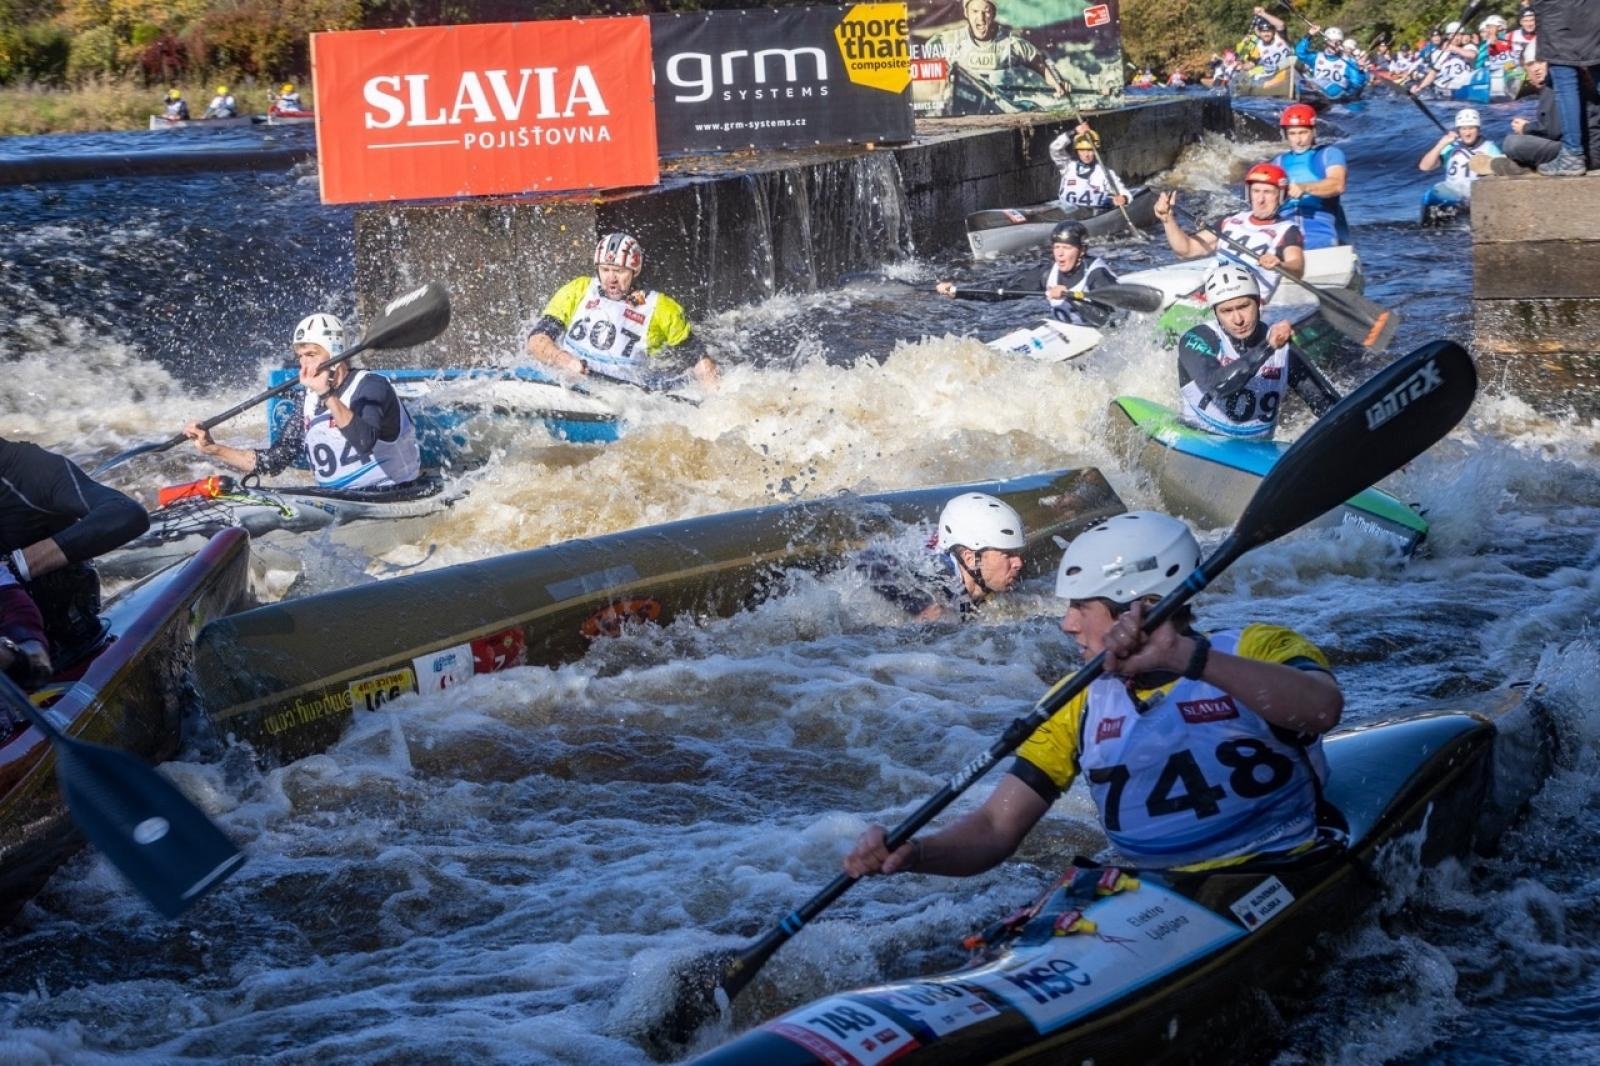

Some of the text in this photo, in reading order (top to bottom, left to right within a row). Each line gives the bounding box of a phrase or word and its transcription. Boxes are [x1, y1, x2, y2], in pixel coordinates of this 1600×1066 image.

[841, 19, 909, 38] more
[844, 36, 911, 60] than
[666, 47, 828, 103] grm
[920, 62, 942, 78] WIN
[363, 65, 610, 129] SLAVIA
[723, 86, 829, 101] SYSTEMS
[695, 118, 806, 132] www.grm-systems.cz
[464, 125, 611, 150] POJIŠŤOVNA
[1448, 161, 1470, 177] 61
[1066, 190, 1104, 206] 647
[568, 317, 642, 358] 607
[1182, 700, 1231, 716] SLAVIA
[1089, 738, 1294, 831] 748
[1127, 904, 1165, 928] Elektro
[1145, 914, 1190, 941] Ljubljana
[806, 1005, 877, 1040] 748
